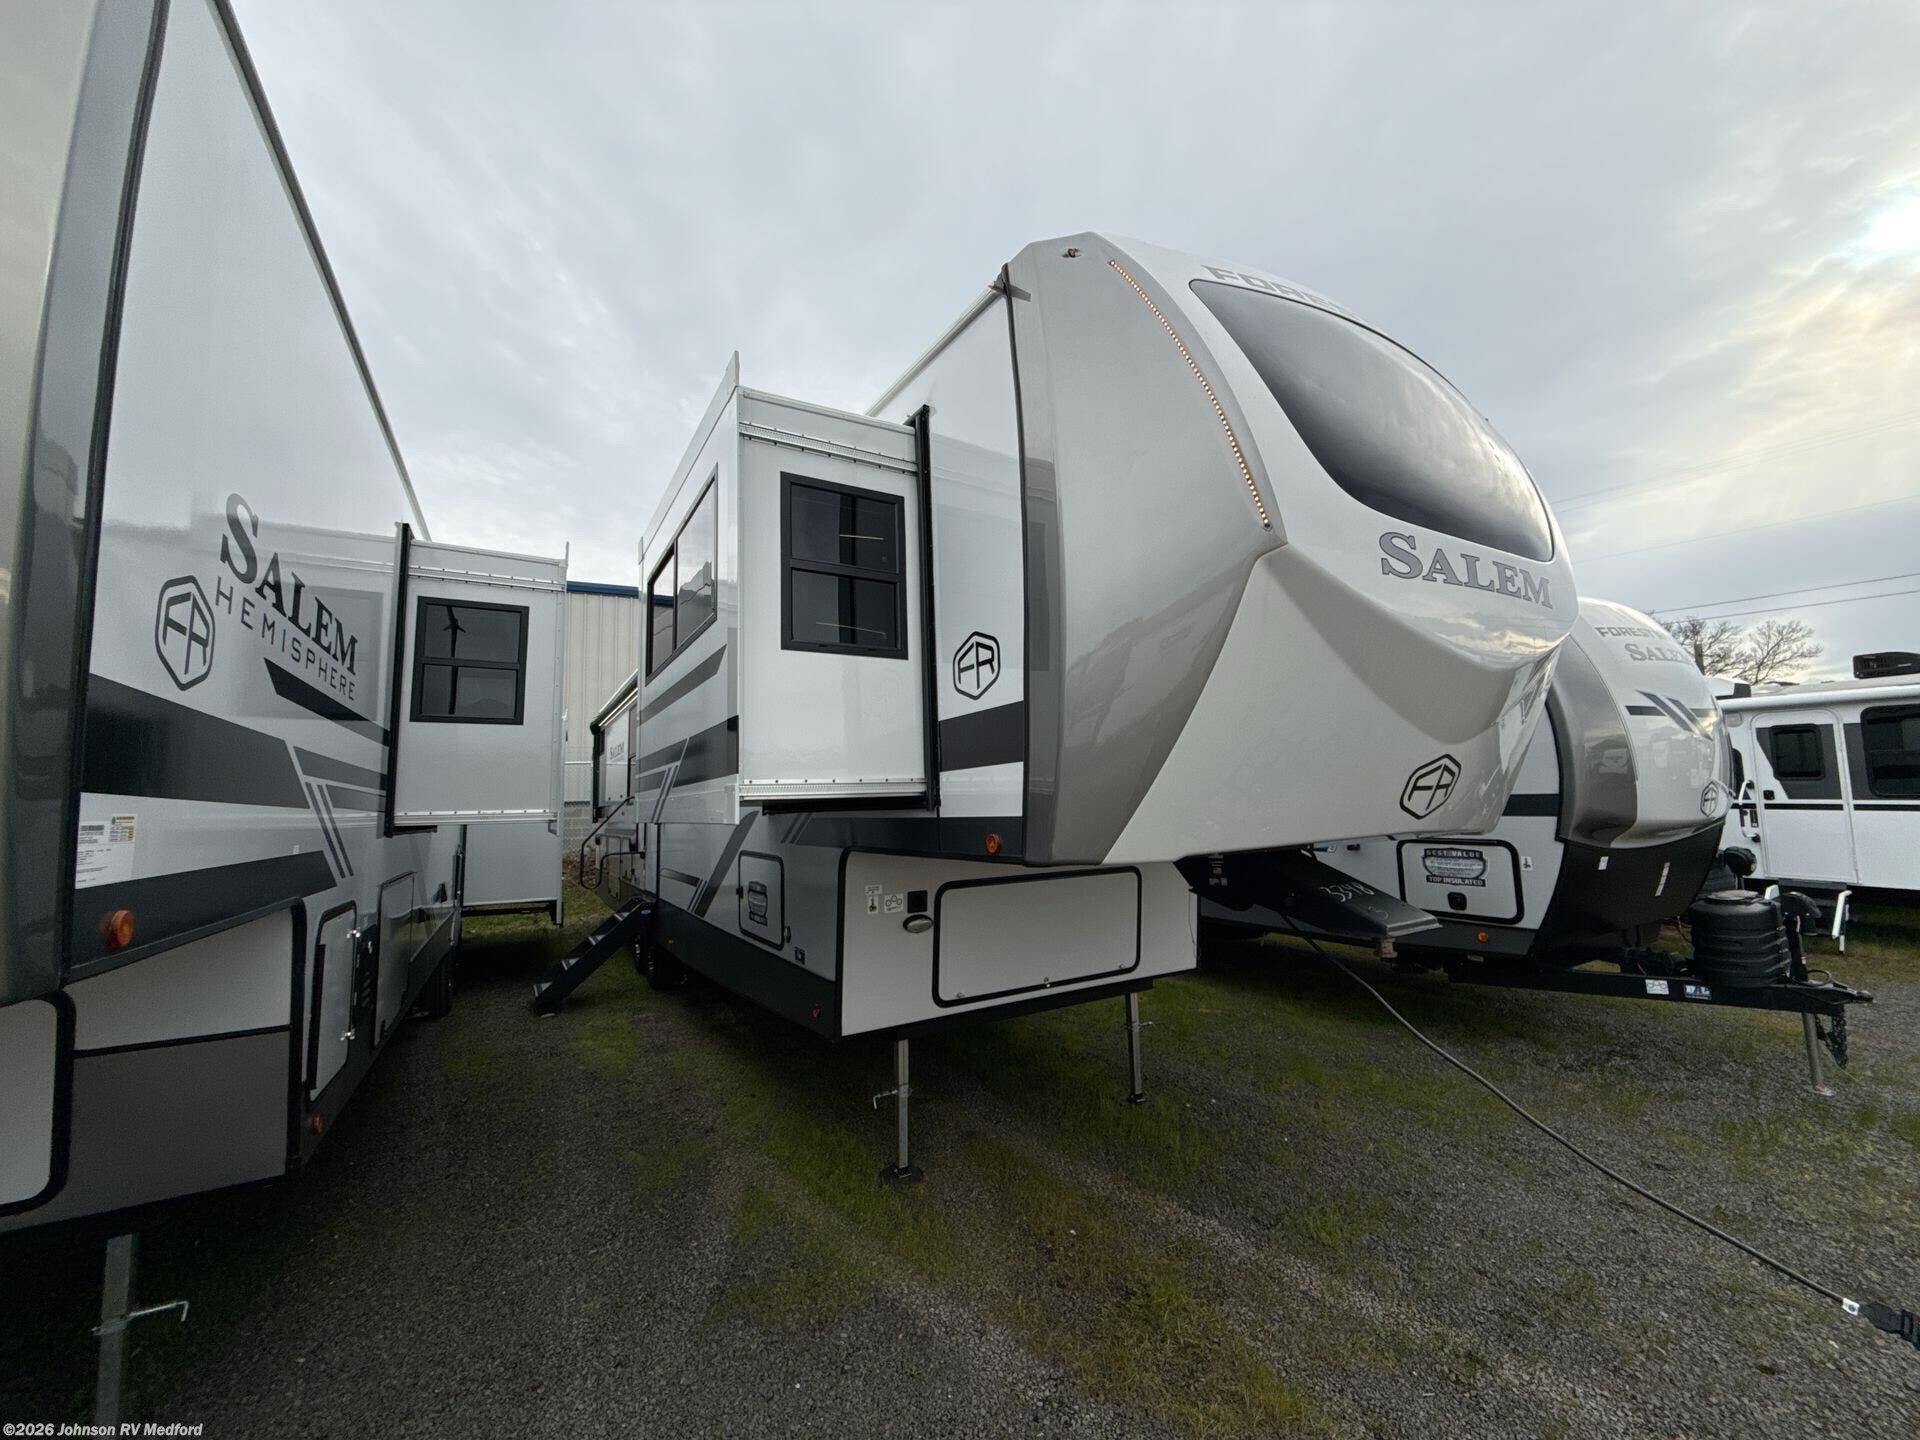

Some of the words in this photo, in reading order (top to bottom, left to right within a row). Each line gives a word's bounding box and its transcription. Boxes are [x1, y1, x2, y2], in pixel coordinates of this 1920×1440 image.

[220, 492, 358, 675] SALEM
[1379, 531, 1553, 609] SALEM
[215, 575, 355, 701] HEMISPHERE
